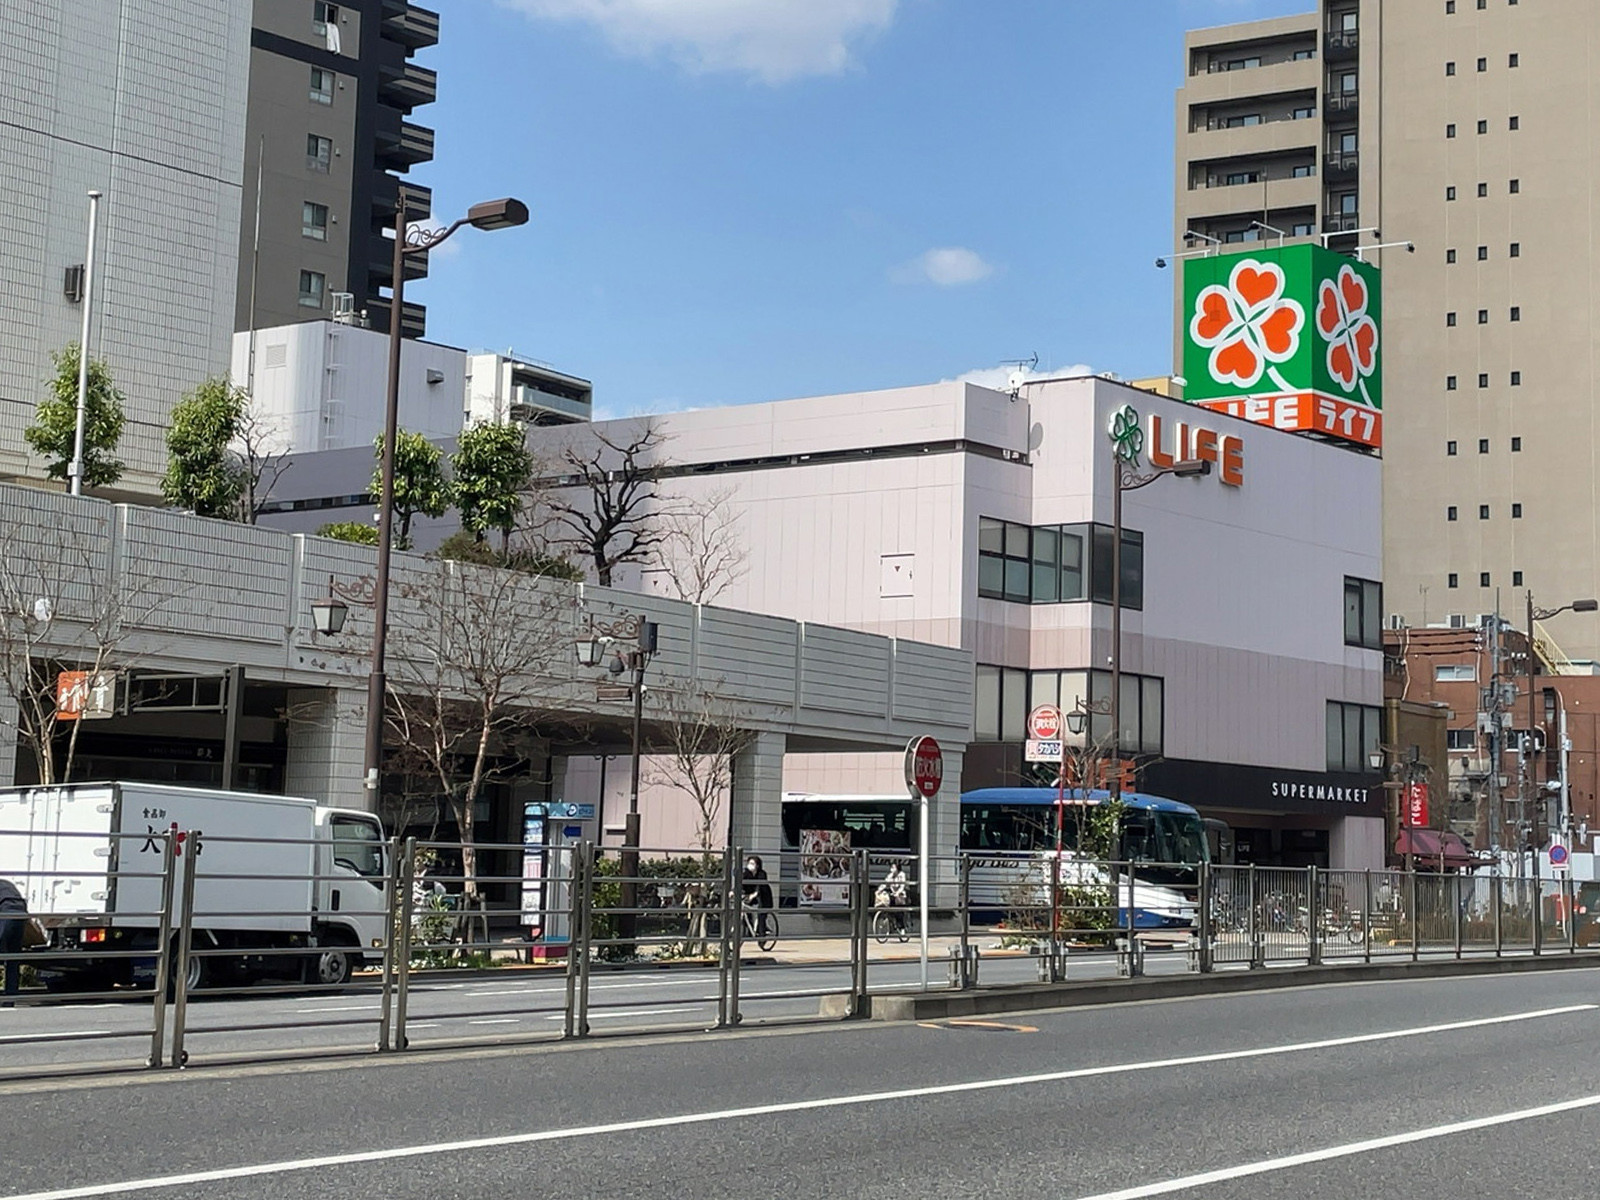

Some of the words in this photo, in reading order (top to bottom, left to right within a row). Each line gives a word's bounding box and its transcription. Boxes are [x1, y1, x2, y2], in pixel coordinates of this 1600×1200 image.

[1318, 399, 1376, 441] ライフ
[1148, 414, 1244, 487] LIFE
[1272, 782, 1368, 803] SUPERMARKET
